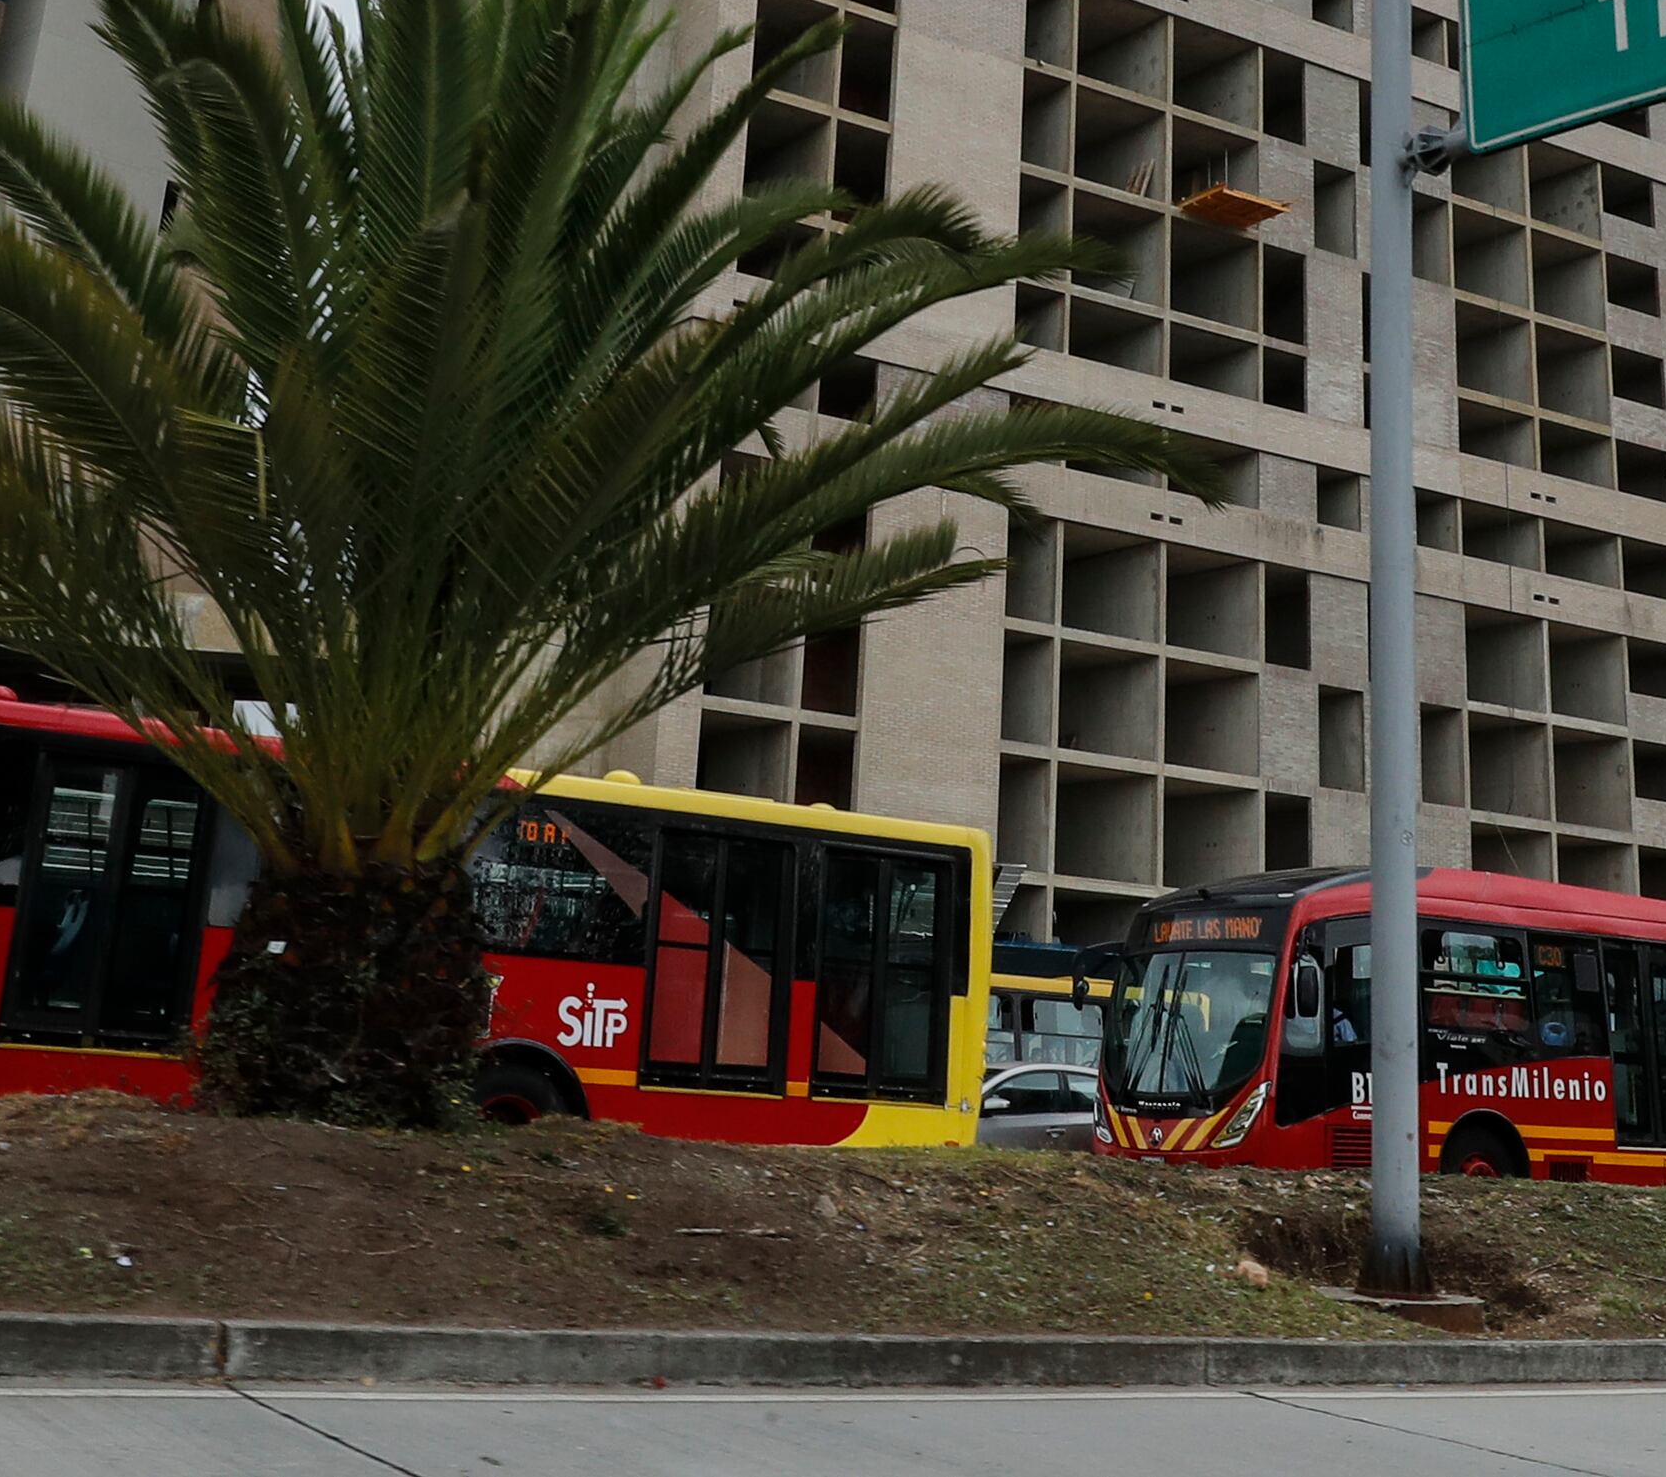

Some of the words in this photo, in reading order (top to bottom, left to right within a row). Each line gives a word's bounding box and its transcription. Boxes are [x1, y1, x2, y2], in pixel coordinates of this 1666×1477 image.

[1197, 918, 1220, 939] LAS
[1225, 916, 1263, 939] MANO
[1436, 1062, 1606, 1101] TransMilenio
